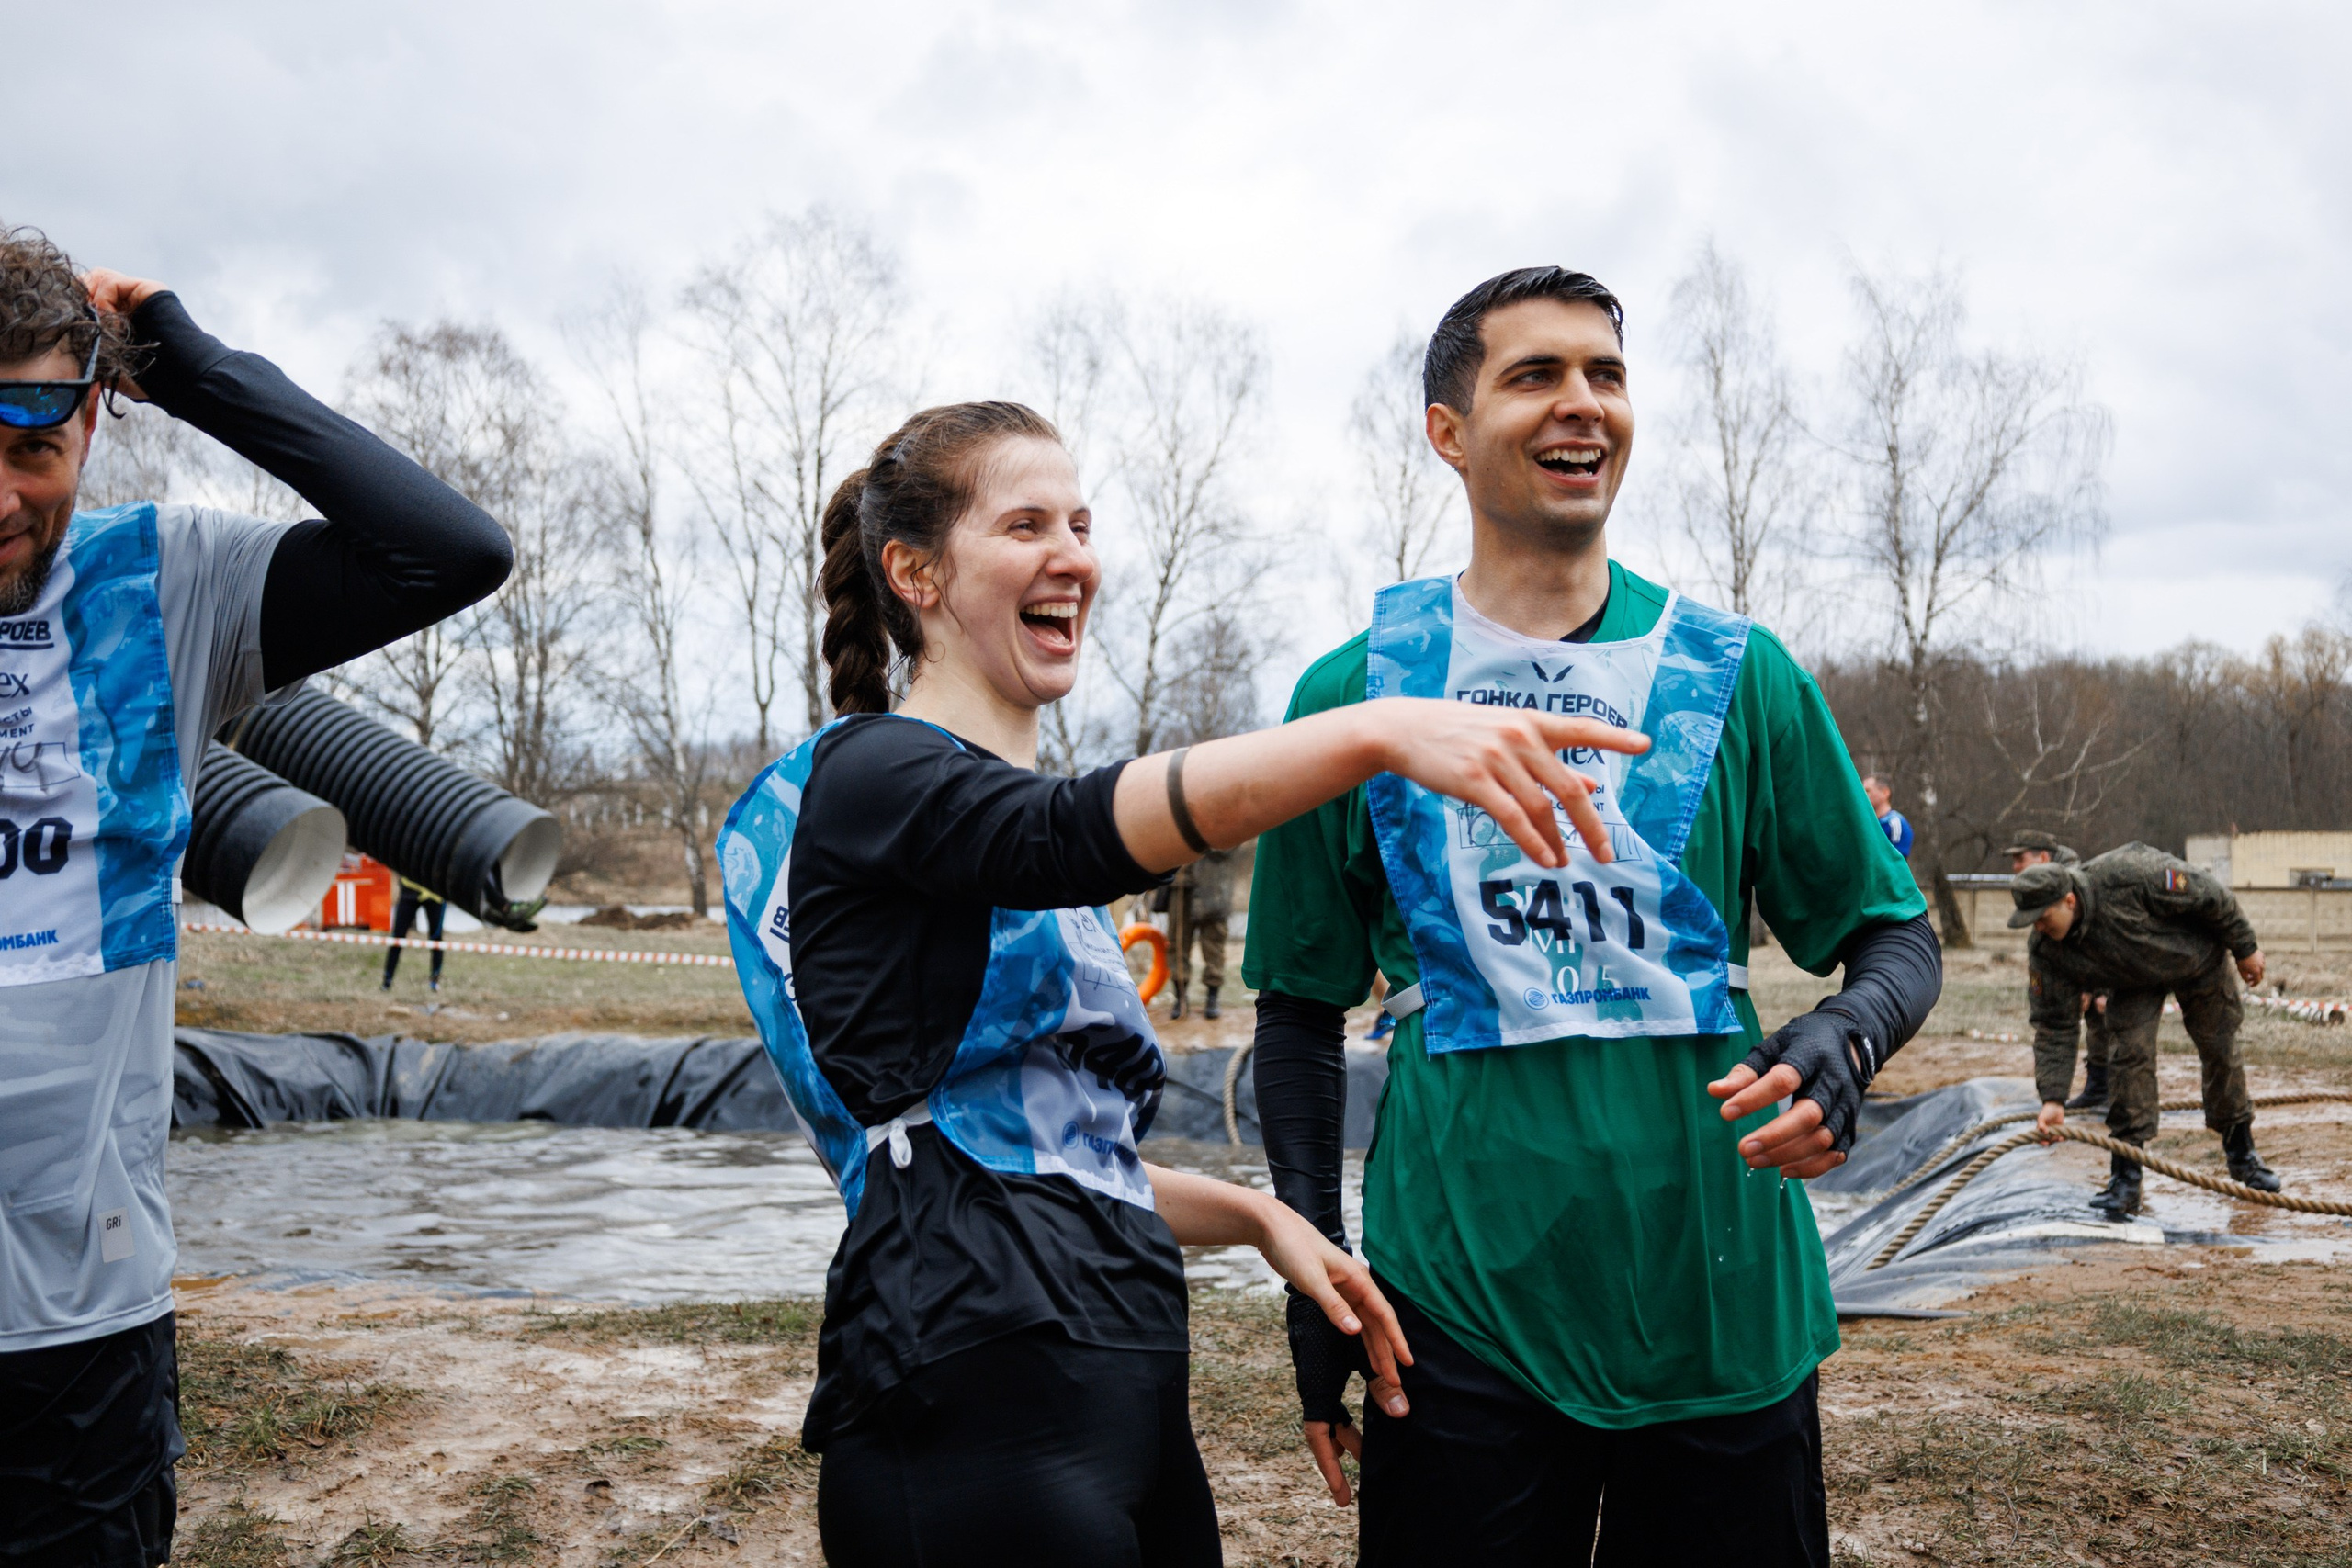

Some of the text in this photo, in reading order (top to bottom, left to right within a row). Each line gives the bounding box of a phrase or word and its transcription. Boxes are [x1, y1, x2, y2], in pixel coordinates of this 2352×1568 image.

[1479, 879, 1645, 950] 5411
[0, 930, 59, 952] МБАНК
[1550, 987, 1652, 1006] ГАЗПРОМБАНК
